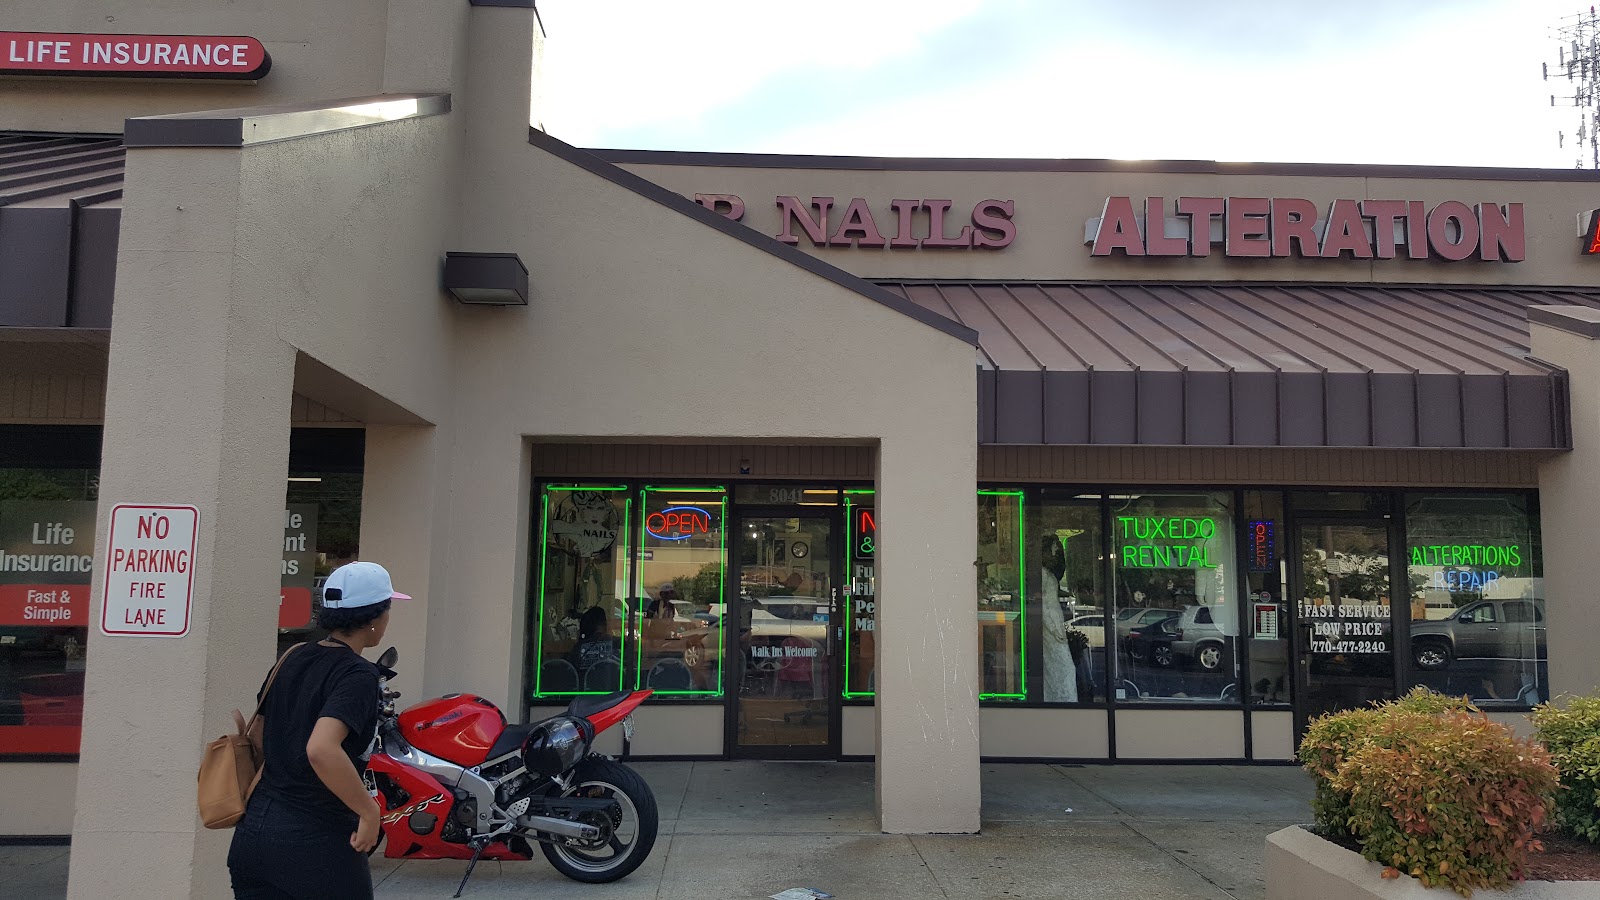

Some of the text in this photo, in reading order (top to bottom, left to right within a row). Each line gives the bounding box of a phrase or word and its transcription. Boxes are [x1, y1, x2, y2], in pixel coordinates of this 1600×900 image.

[9, 40, 249, 66] LIFE INSURANCE
[775, 195, 1017, 249] NAILS
[1090, 196, 1525, 261] ALTERATION
[32, 522, 75, 545] Life
[137, 515, 170, 539] NO
[583, 528, 615, 539] NAILS
[646, 512, 709, 533] OPEN
[1118, 517, 1215, 539] TUXEDO
[1123, 545, 1217, 568] RENTAL
[1256, 524, 1266, 568] OPEN
[1411, 545, 1521, 567] ALTERATIONS
[0, 549, 93, 573] Insuranc
[113, 548, 187, 574] PARKING
[129, 582, 166, 599] FIRE
[1434, 570, 1499, 592] REPAIR
[27, 589, 71, 604] Fast &
[24, 606, 71, 622] Simple
[124, 608, 166, 625] LANE
[1305, 605, 1391, 619] FAST SERVICE
[1315, 623, 1383, 637] LOW PRICE
[785, 645, 818, 658] Welcome
[1313, 641, 1386, 654] 770-477-2240
